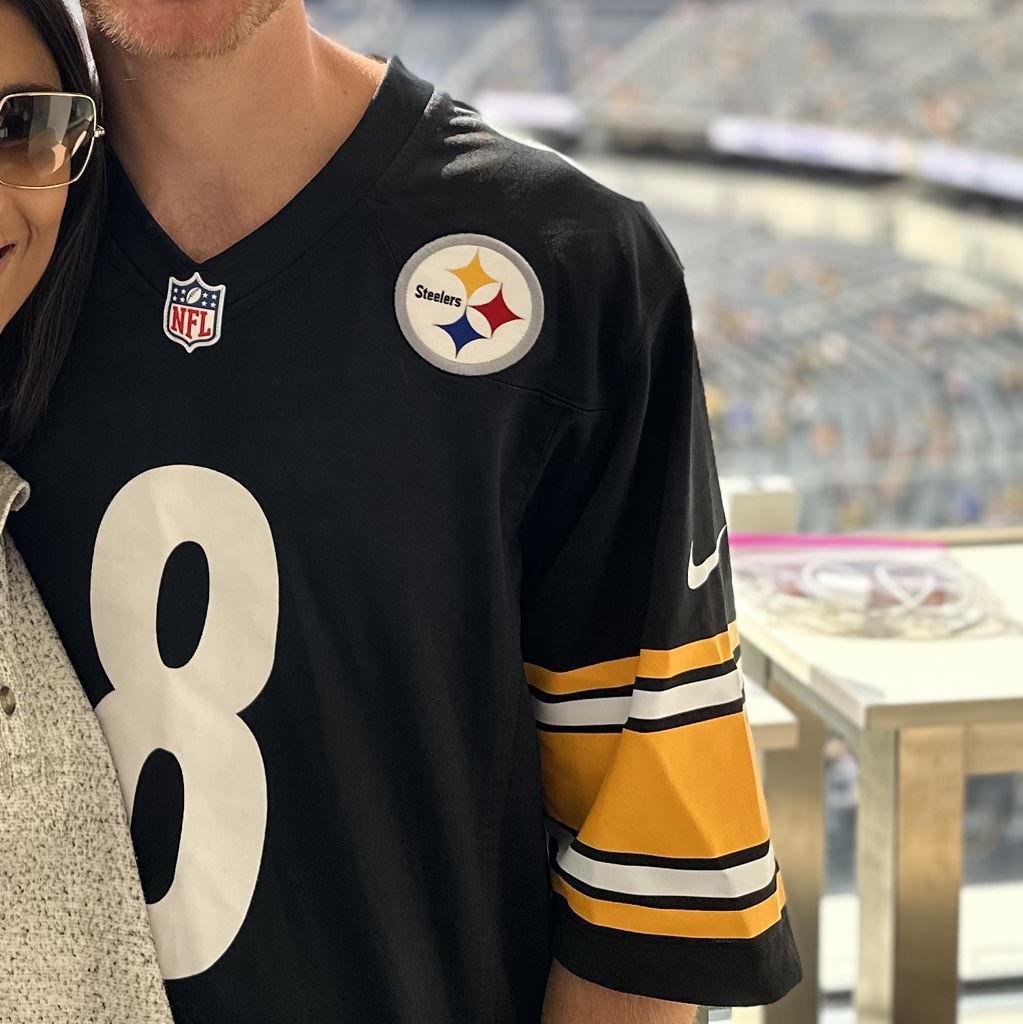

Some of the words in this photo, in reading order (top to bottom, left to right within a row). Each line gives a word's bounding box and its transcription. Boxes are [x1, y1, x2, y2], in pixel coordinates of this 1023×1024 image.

[414, 284, 462, 308] Steelers
[170, 305, 212, 340] NFL
[89, 464, 280, 980] 8
